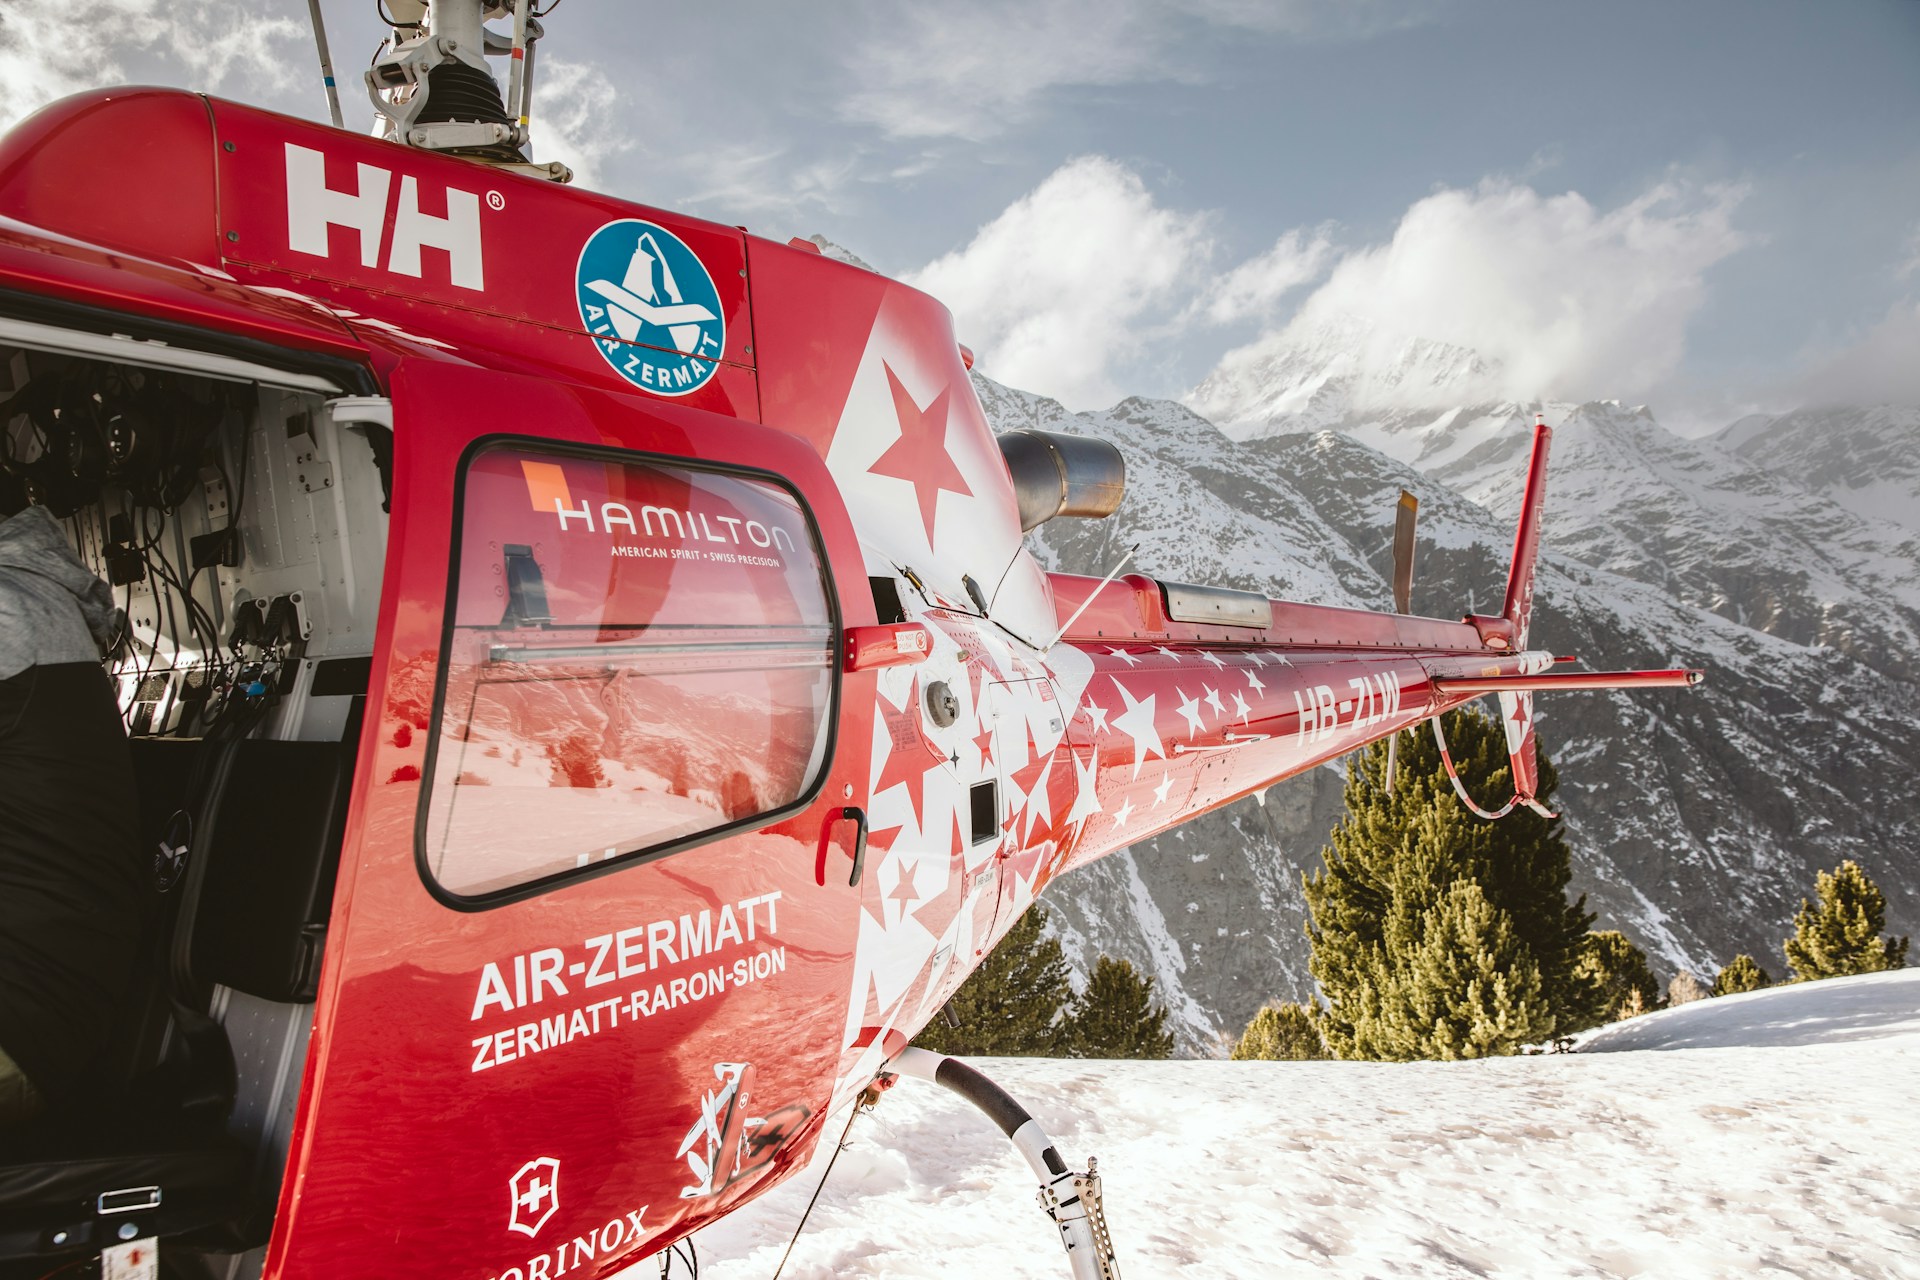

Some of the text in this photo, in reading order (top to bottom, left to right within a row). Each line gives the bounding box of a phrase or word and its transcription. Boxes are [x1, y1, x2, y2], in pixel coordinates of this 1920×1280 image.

[585, 304, 719, 388] AIR ZERMATT
[555, 497, 796, 553] HAMILTON
[611, 546, 780, 568] AMERICAN SPIRIT SWISS PRECISION
[1293, 670, 1401, 748] HB-ZLW
[470, 890, 782, 1021] AIR-ZERMATT
[471, 946, 786, 1073] ZERMATT-RARON-SION
